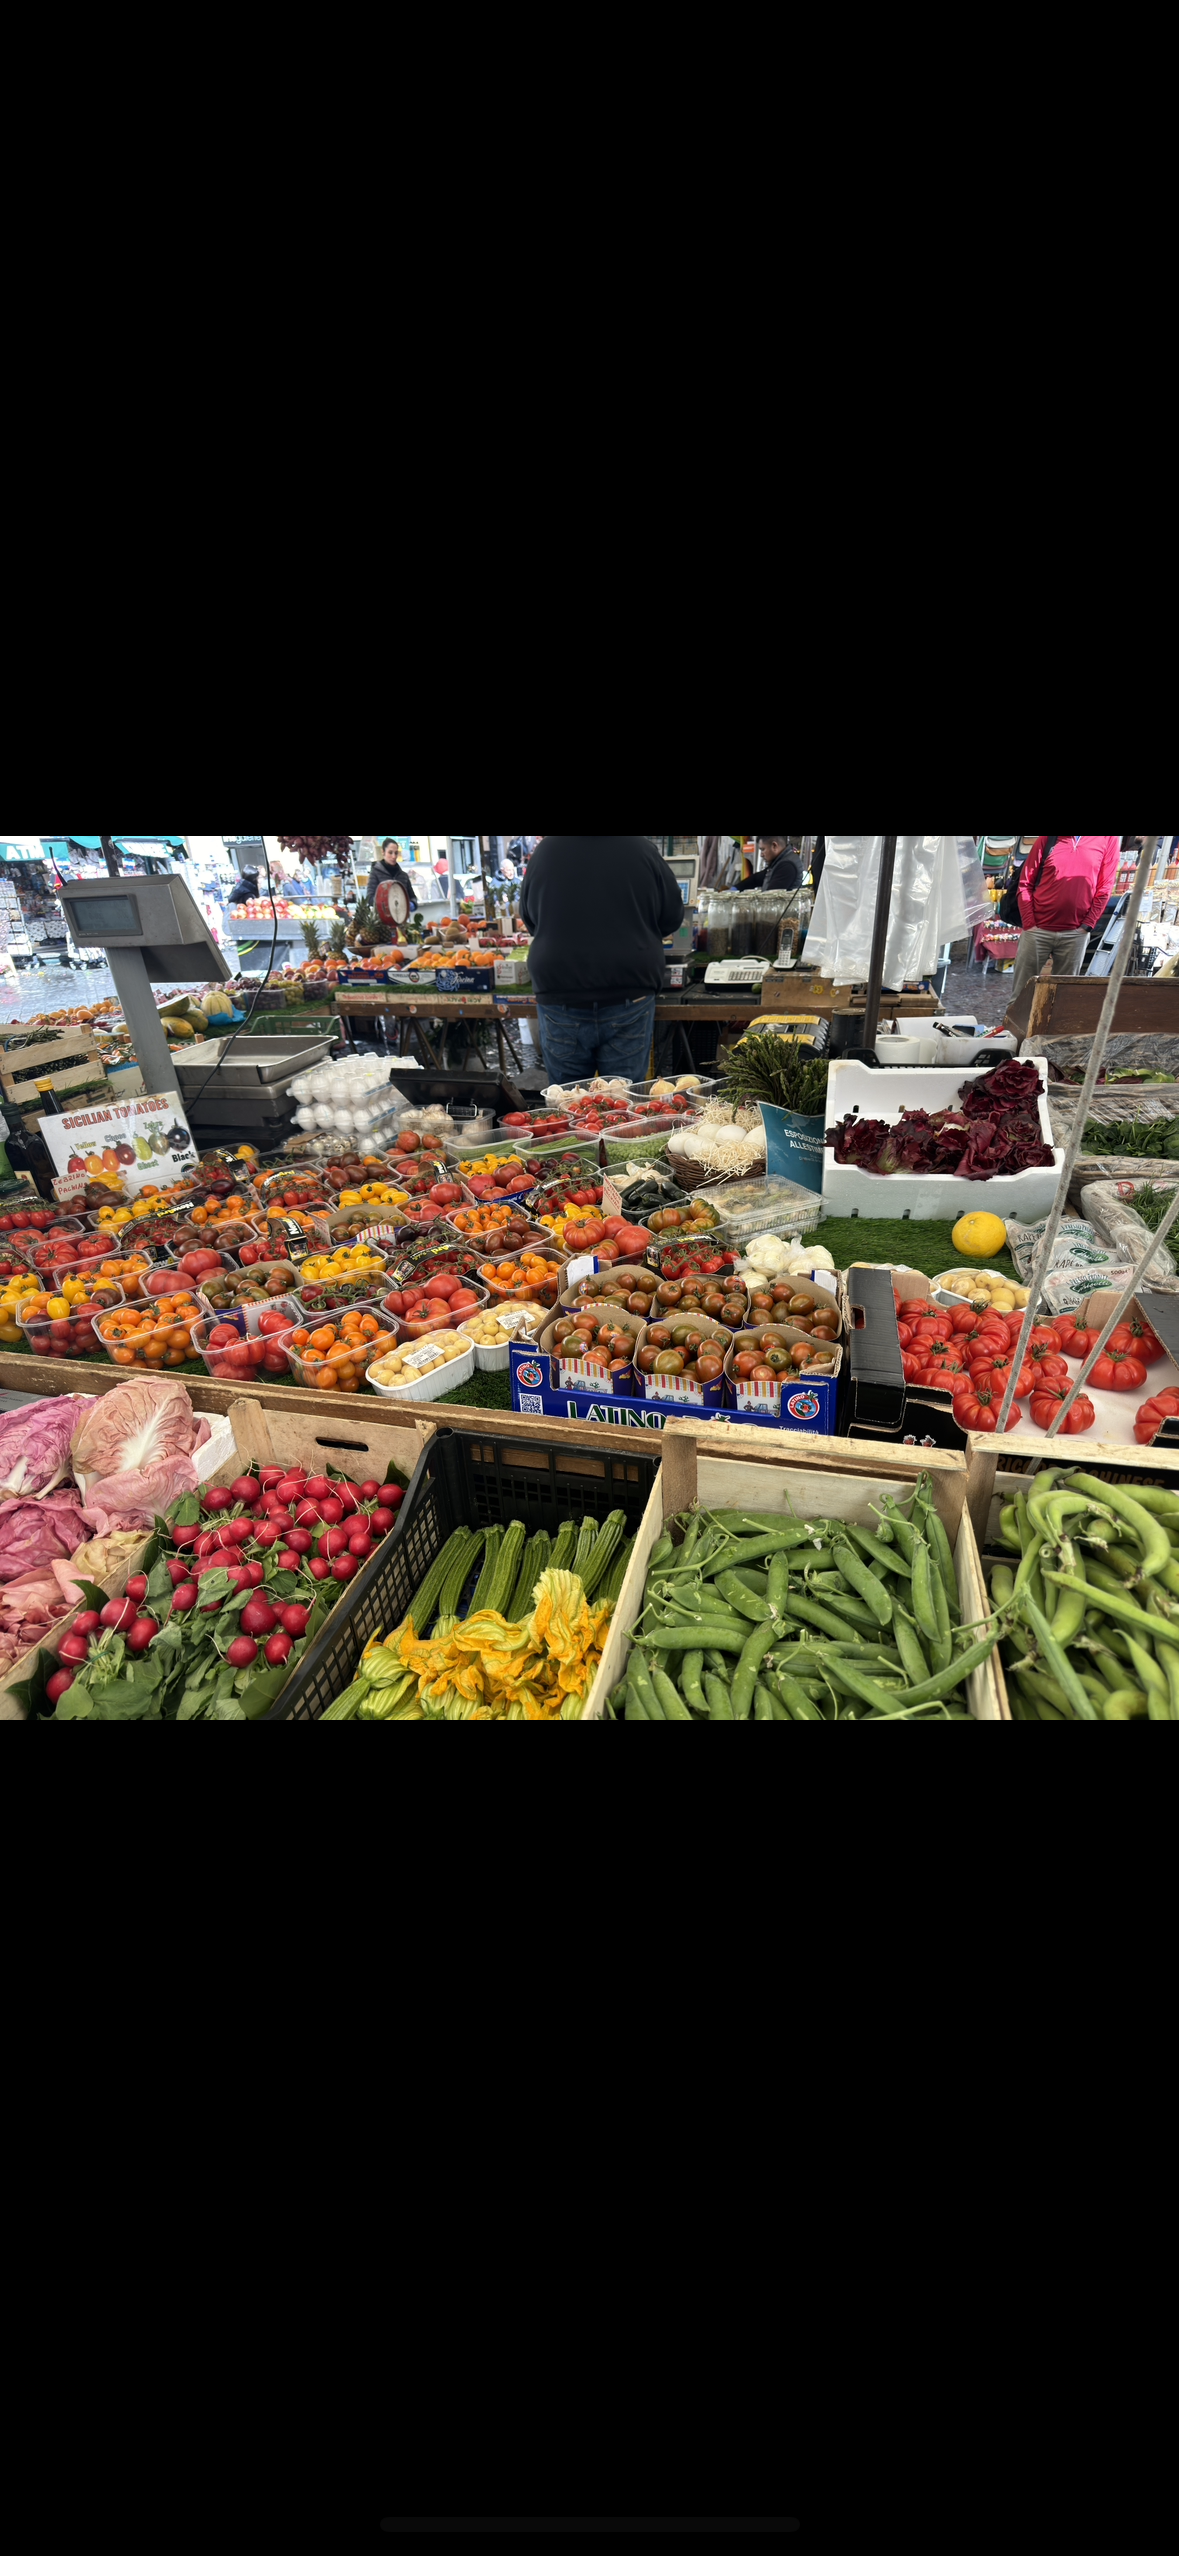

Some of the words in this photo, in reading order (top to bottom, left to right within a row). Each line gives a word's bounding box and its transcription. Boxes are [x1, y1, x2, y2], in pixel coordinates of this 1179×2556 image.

[61, 1109, 113, 1130] SICILIAN
[112, 1098, 169, 1119] TOMATOES
[74, 1141, 97, 1150] Yellow
[566, 1400, 668, 1430] LATINO
